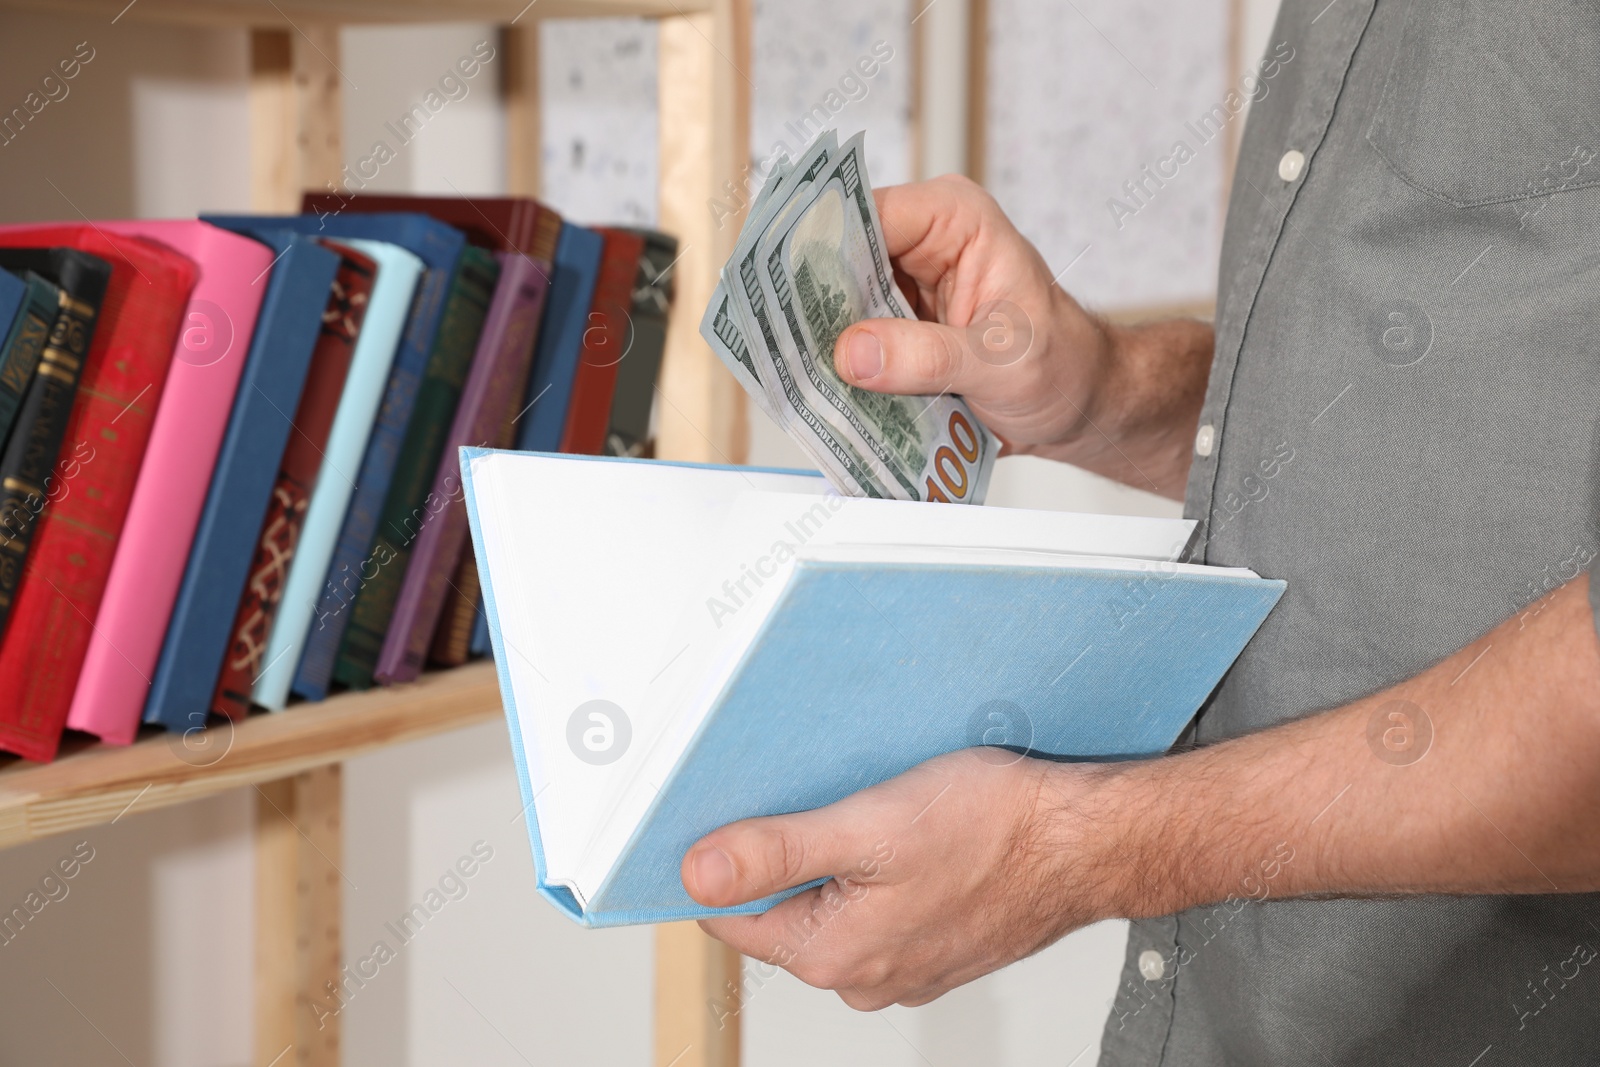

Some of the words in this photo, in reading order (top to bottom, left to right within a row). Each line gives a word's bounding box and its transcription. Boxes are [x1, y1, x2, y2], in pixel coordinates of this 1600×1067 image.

[870, 287, 879, 308] GOD
[775, 356, 789, 382] ONE
[814, 423, 852, 469] DOLLARS
[802, 350, 814, 376] ONE
[810, 370, 851, 419] HUNDRED
[850, 416, 887, 461] DOLLARS
